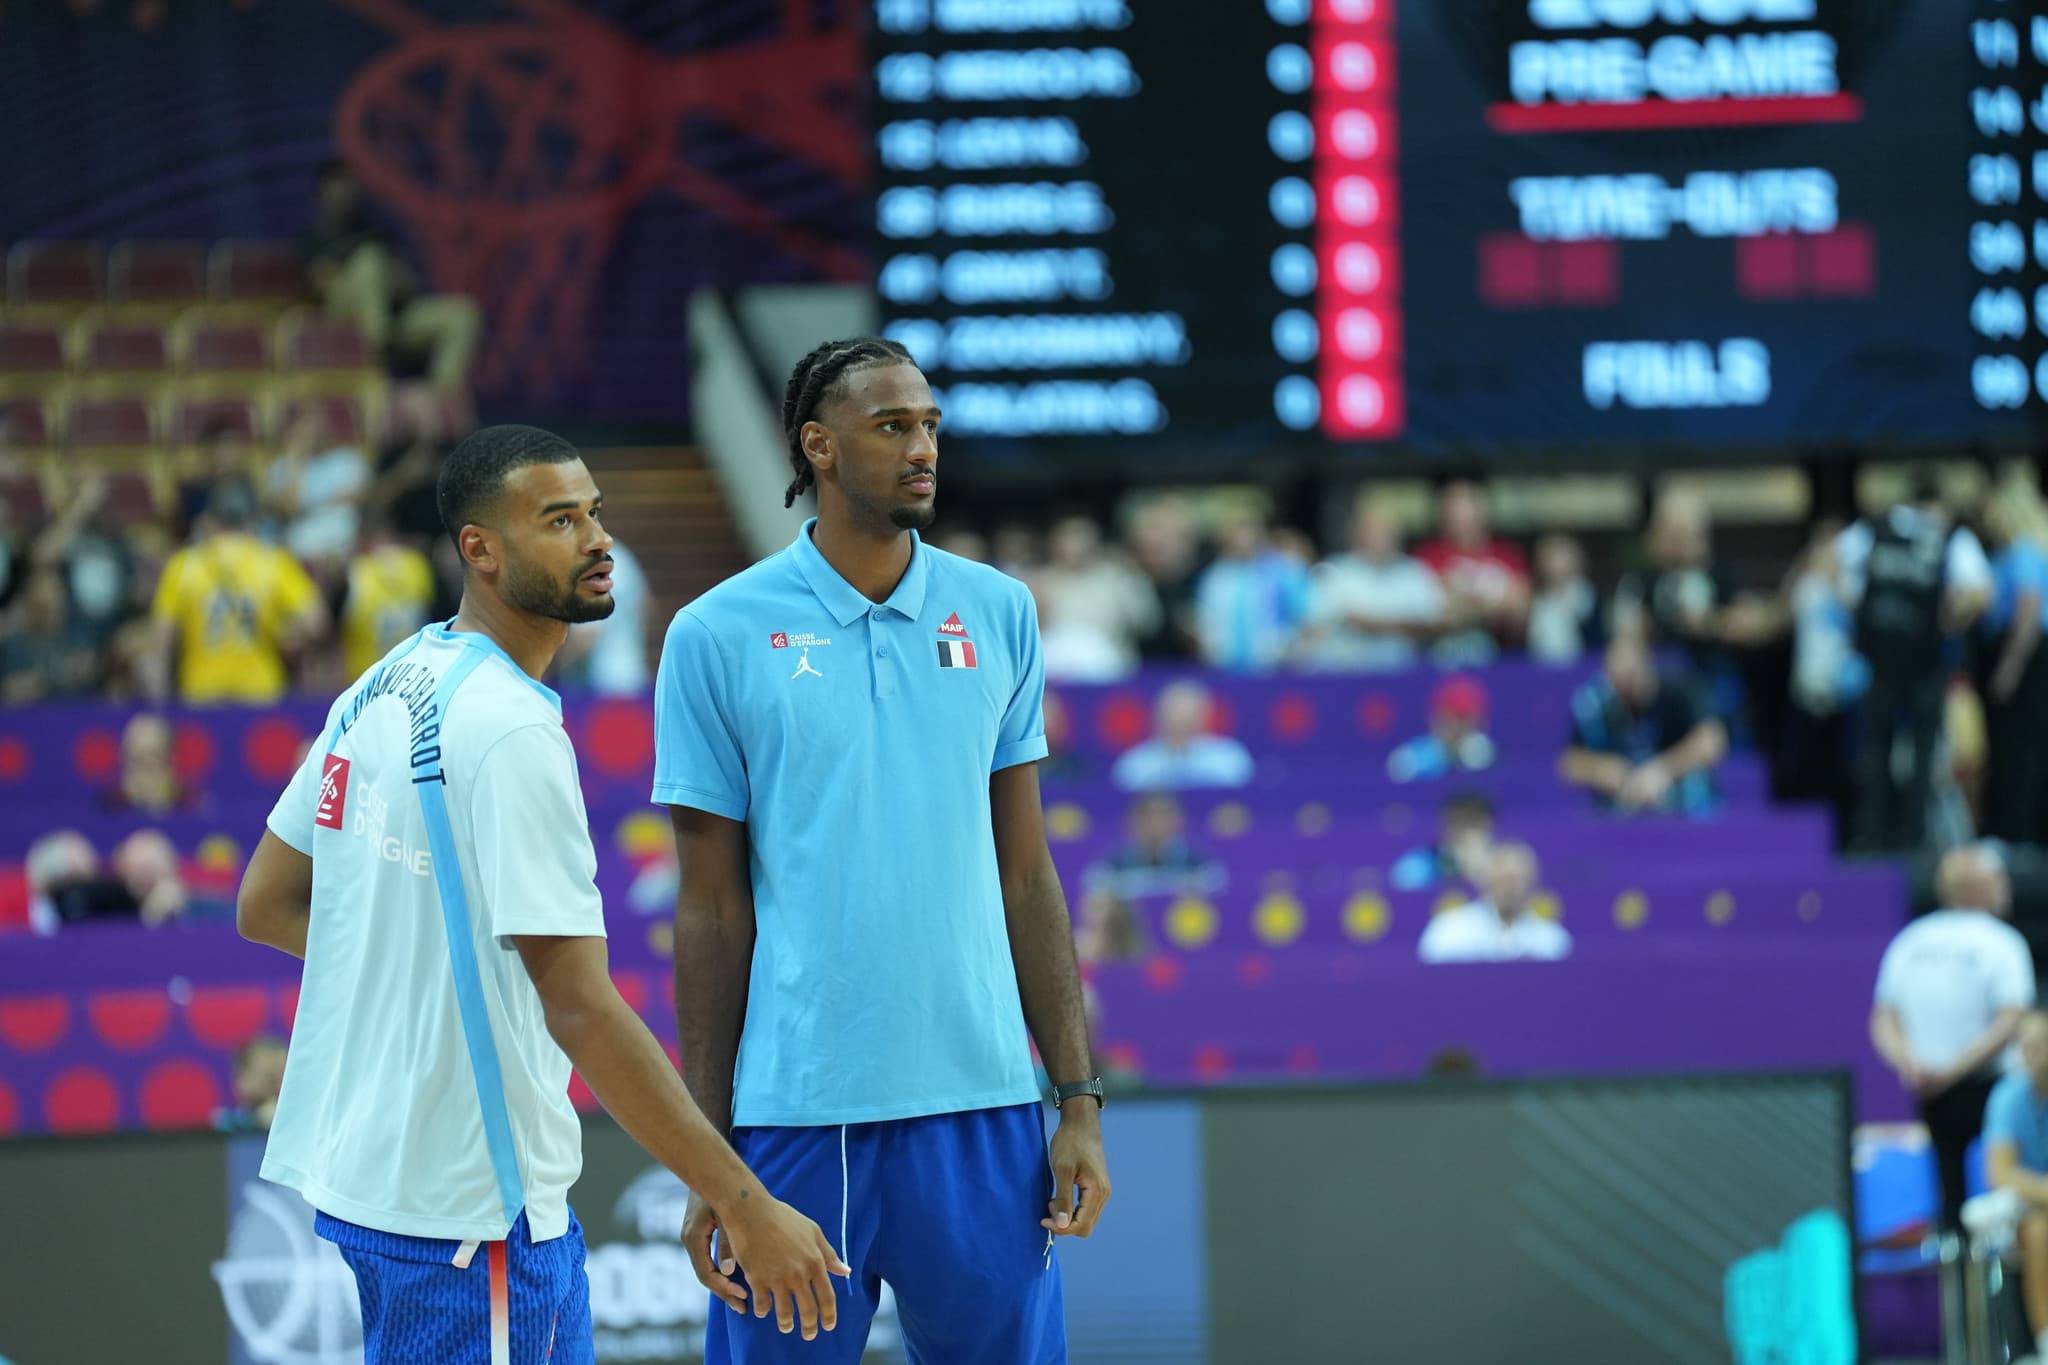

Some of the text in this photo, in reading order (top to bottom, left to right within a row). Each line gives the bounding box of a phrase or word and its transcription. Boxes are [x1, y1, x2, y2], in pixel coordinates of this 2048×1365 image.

[1509, 31, 1838, 104] PRE-GAME
[1509, 169, 1837, 240] TIME-OUTS
[1583, 338, 1771, 408] FOULS
[789, 633, 815, 641] CAISSE
[941, 624, 964, 632] MAIF
